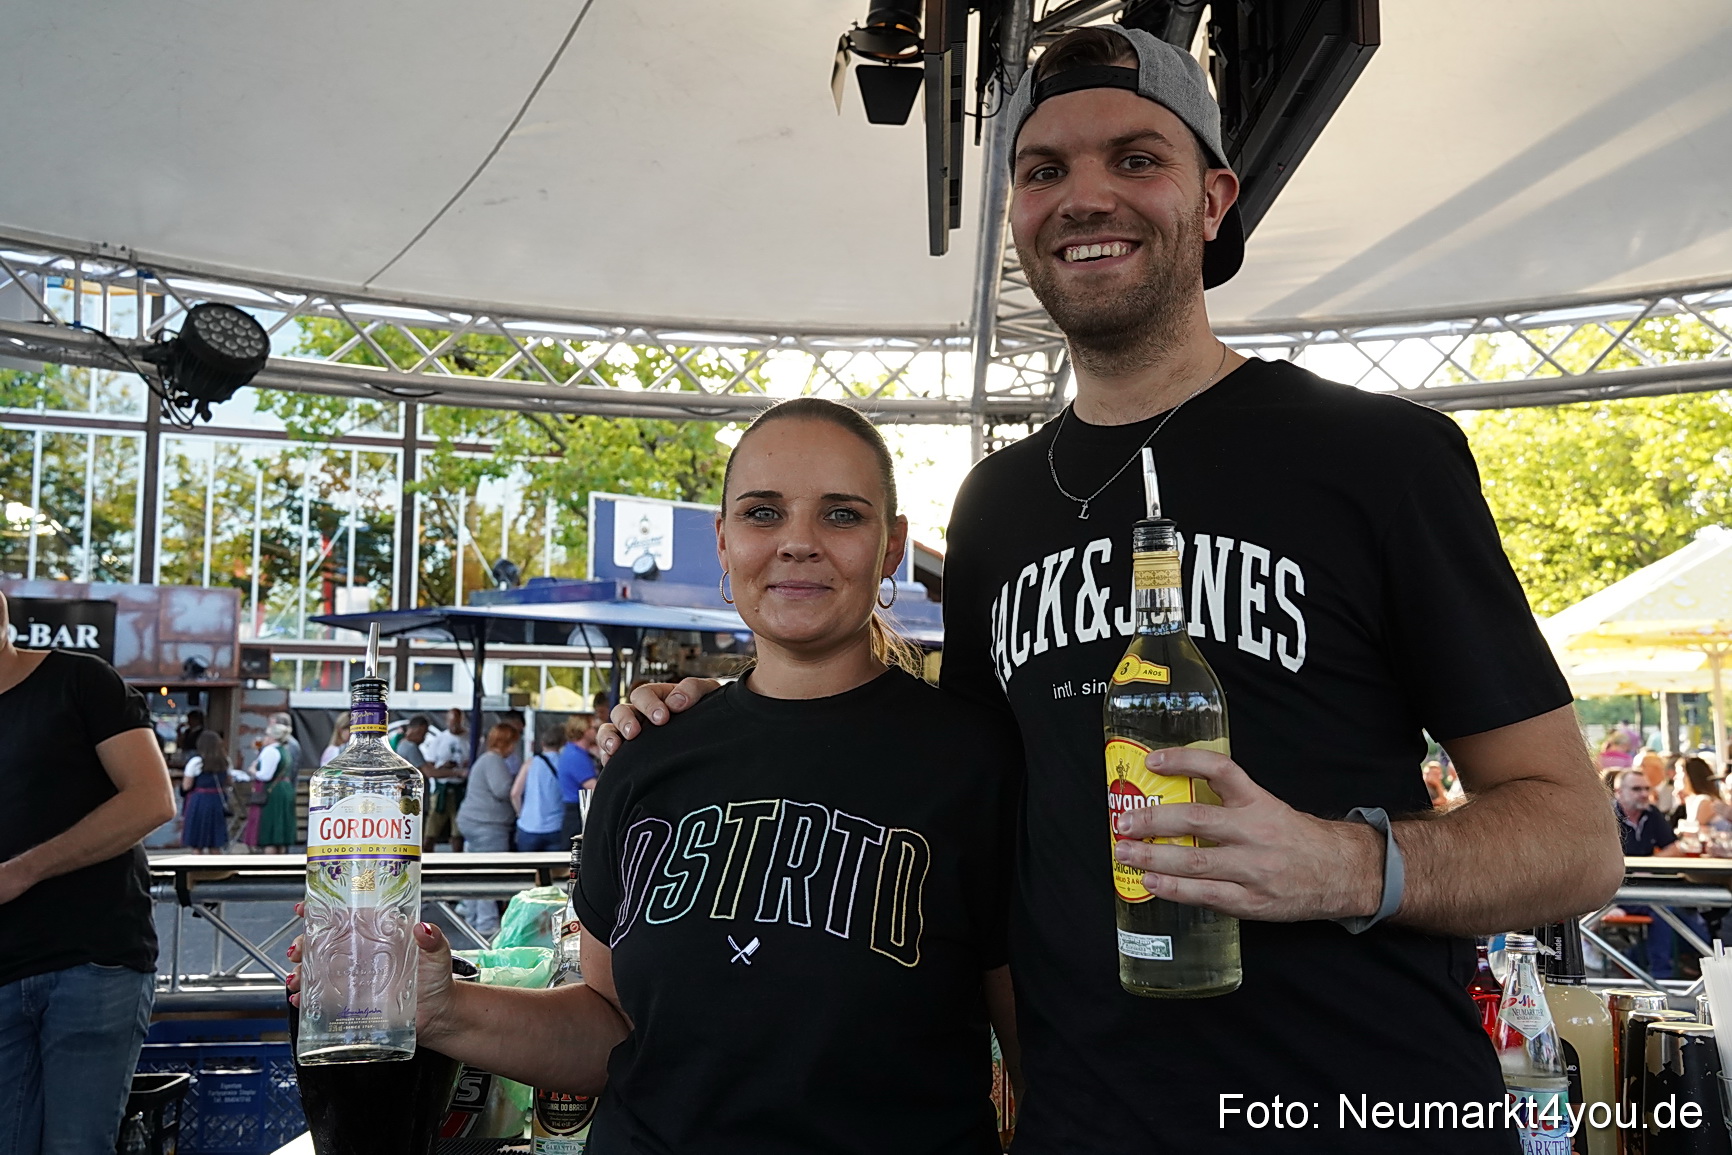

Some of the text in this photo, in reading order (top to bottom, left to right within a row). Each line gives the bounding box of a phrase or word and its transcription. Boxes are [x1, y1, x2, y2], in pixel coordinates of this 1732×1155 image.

[1053, 680, 1107, 699] intl. sin
[320, 816, 414, 841] GORDON'S
[321, 846, 363, 854] LONDON
